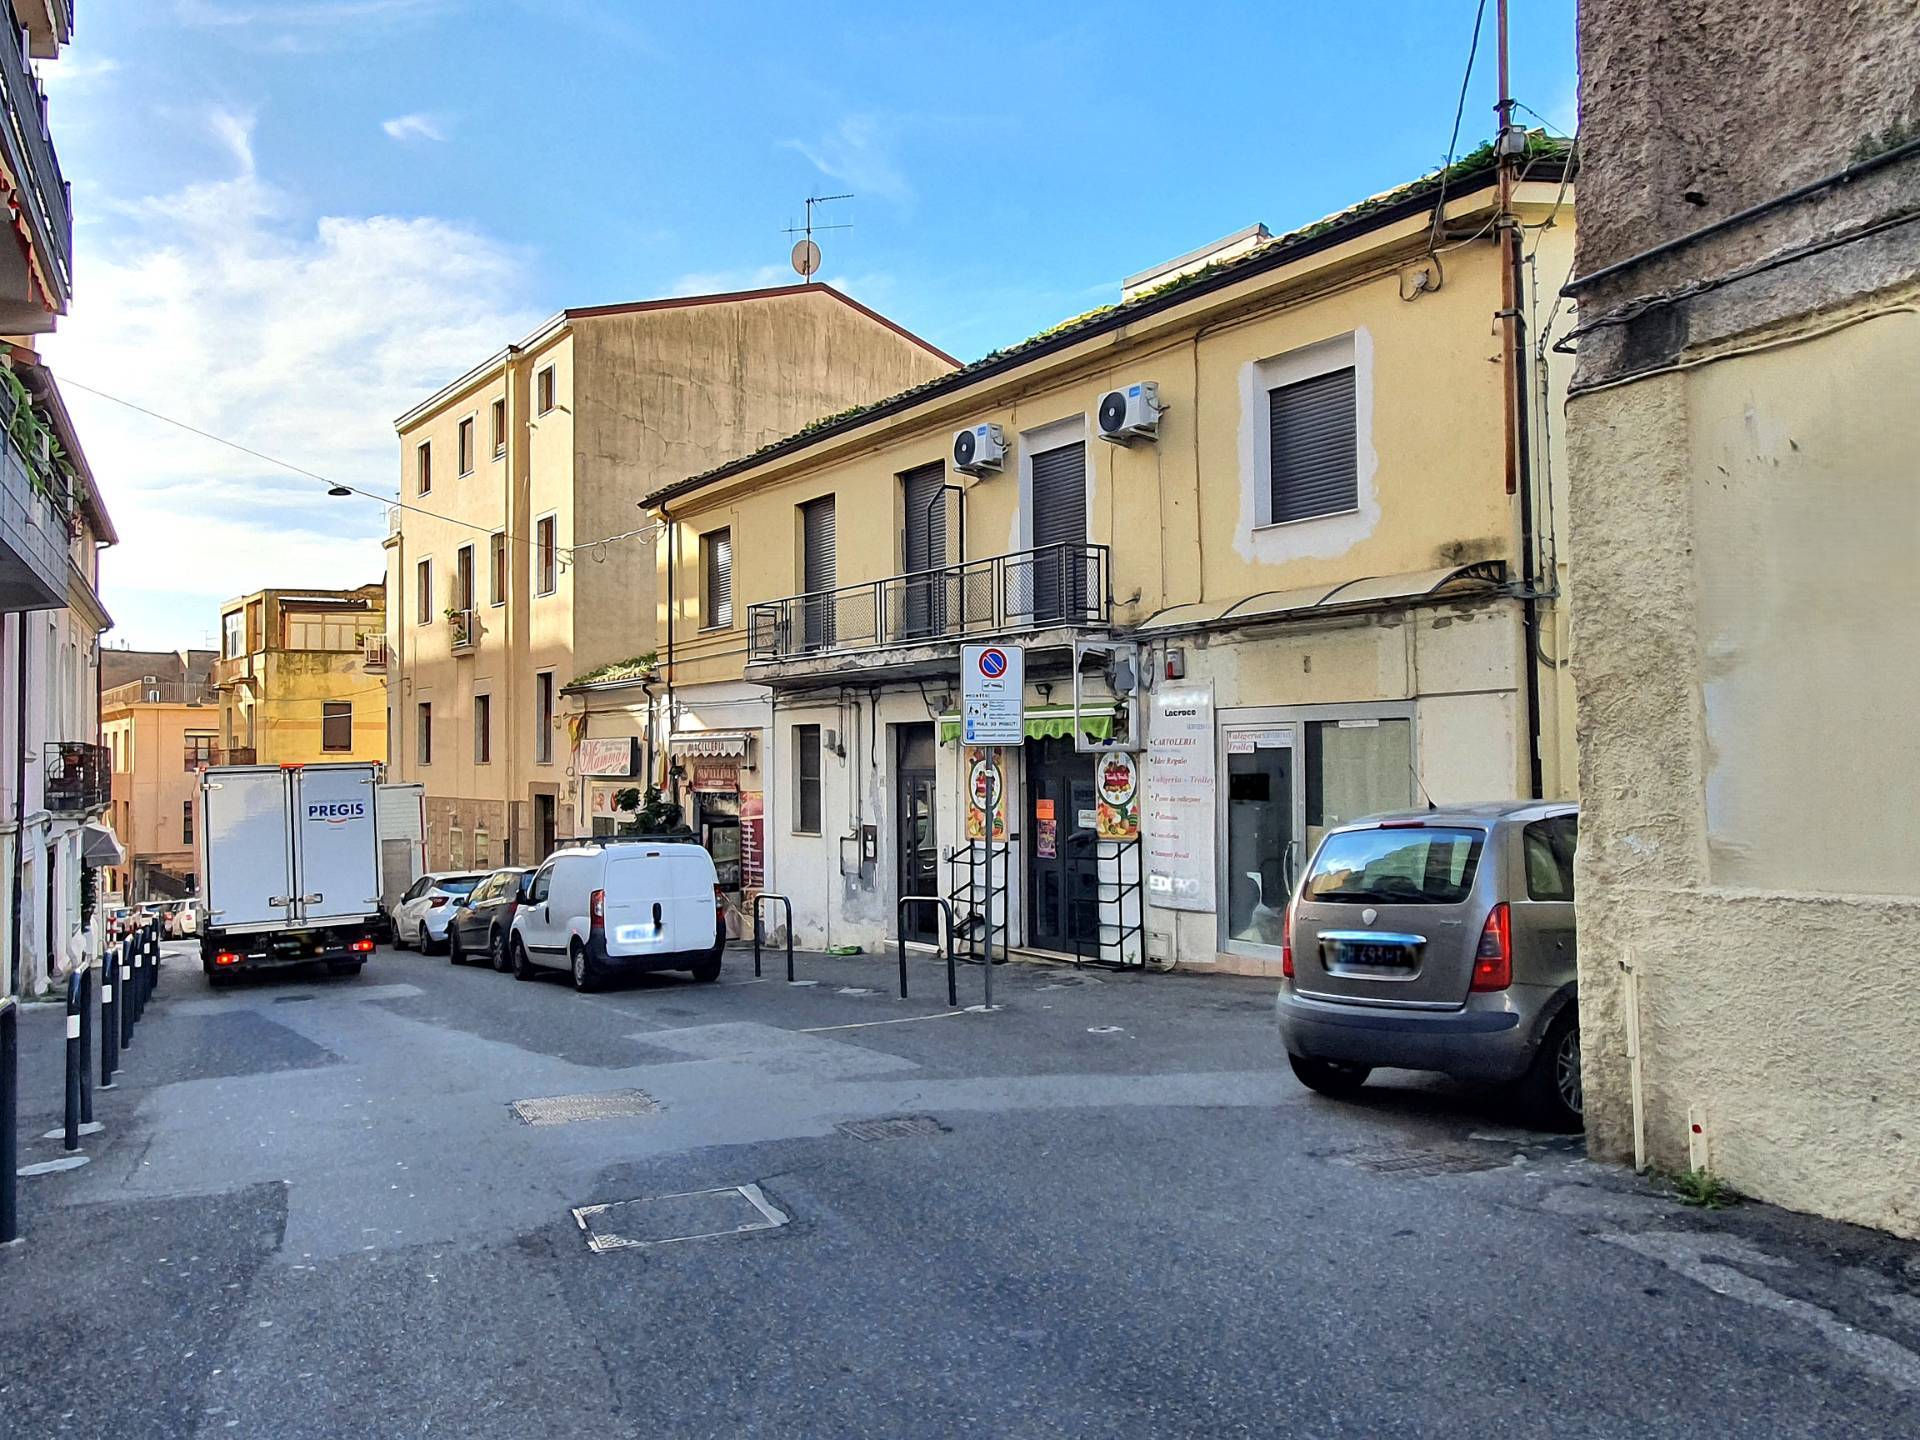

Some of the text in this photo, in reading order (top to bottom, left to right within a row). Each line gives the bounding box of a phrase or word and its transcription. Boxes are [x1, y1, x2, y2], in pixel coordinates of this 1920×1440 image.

[1153, 737, 1197, 746] CARTOLERIA
[1189, 775, 1214, 786] Trolley
[308, 803, 364, 817] PREGIS
